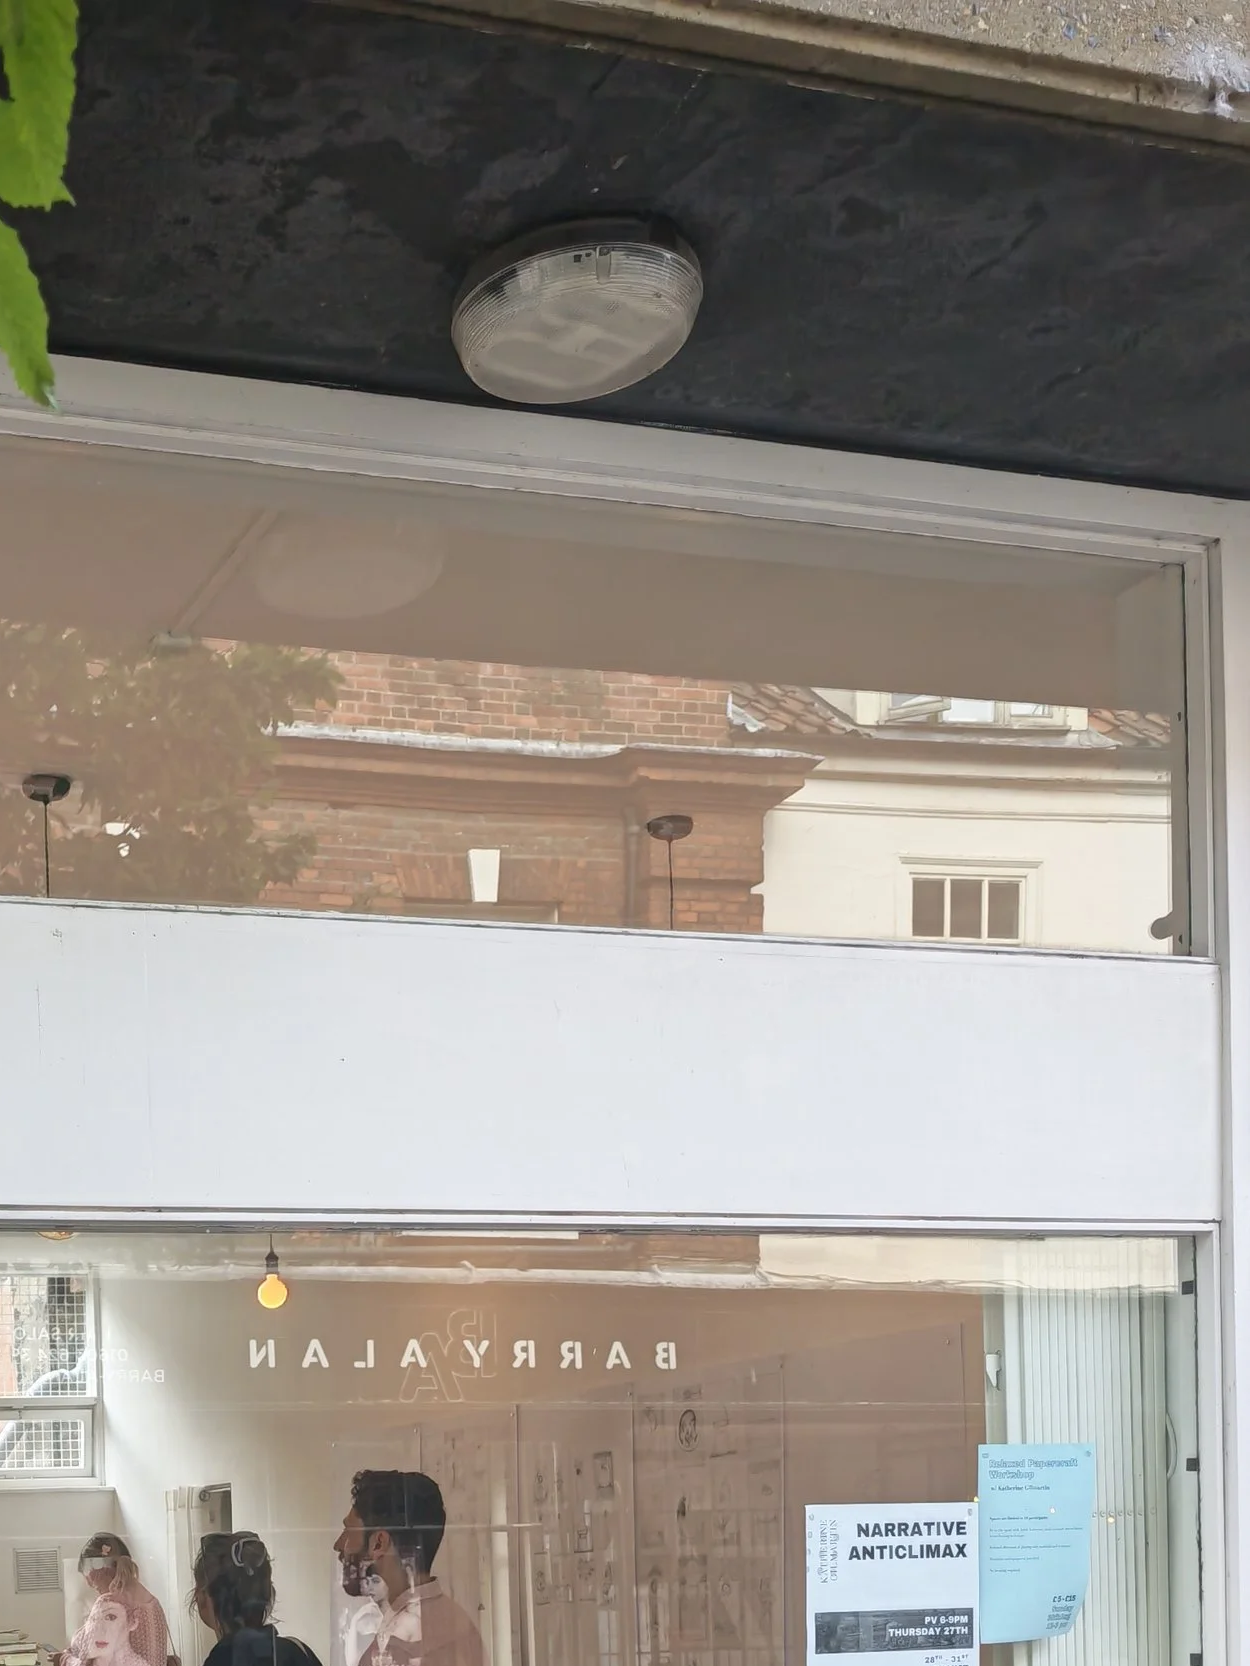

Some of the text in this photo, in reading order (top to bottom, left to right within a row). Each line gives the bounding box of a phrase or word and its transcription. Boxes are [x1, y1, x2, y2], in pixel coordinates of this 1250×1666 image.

[989, 1470, 1035, 1480] Workshop
[856, 1521, 968, 1538] NARRATIVE
[848, 1543, 968, 1561] ANTICLIMAX
[924, 1615, 969, 1625] PV 6-9PM
[888, 1626, 969, 1638] THURSDAY 27TH
